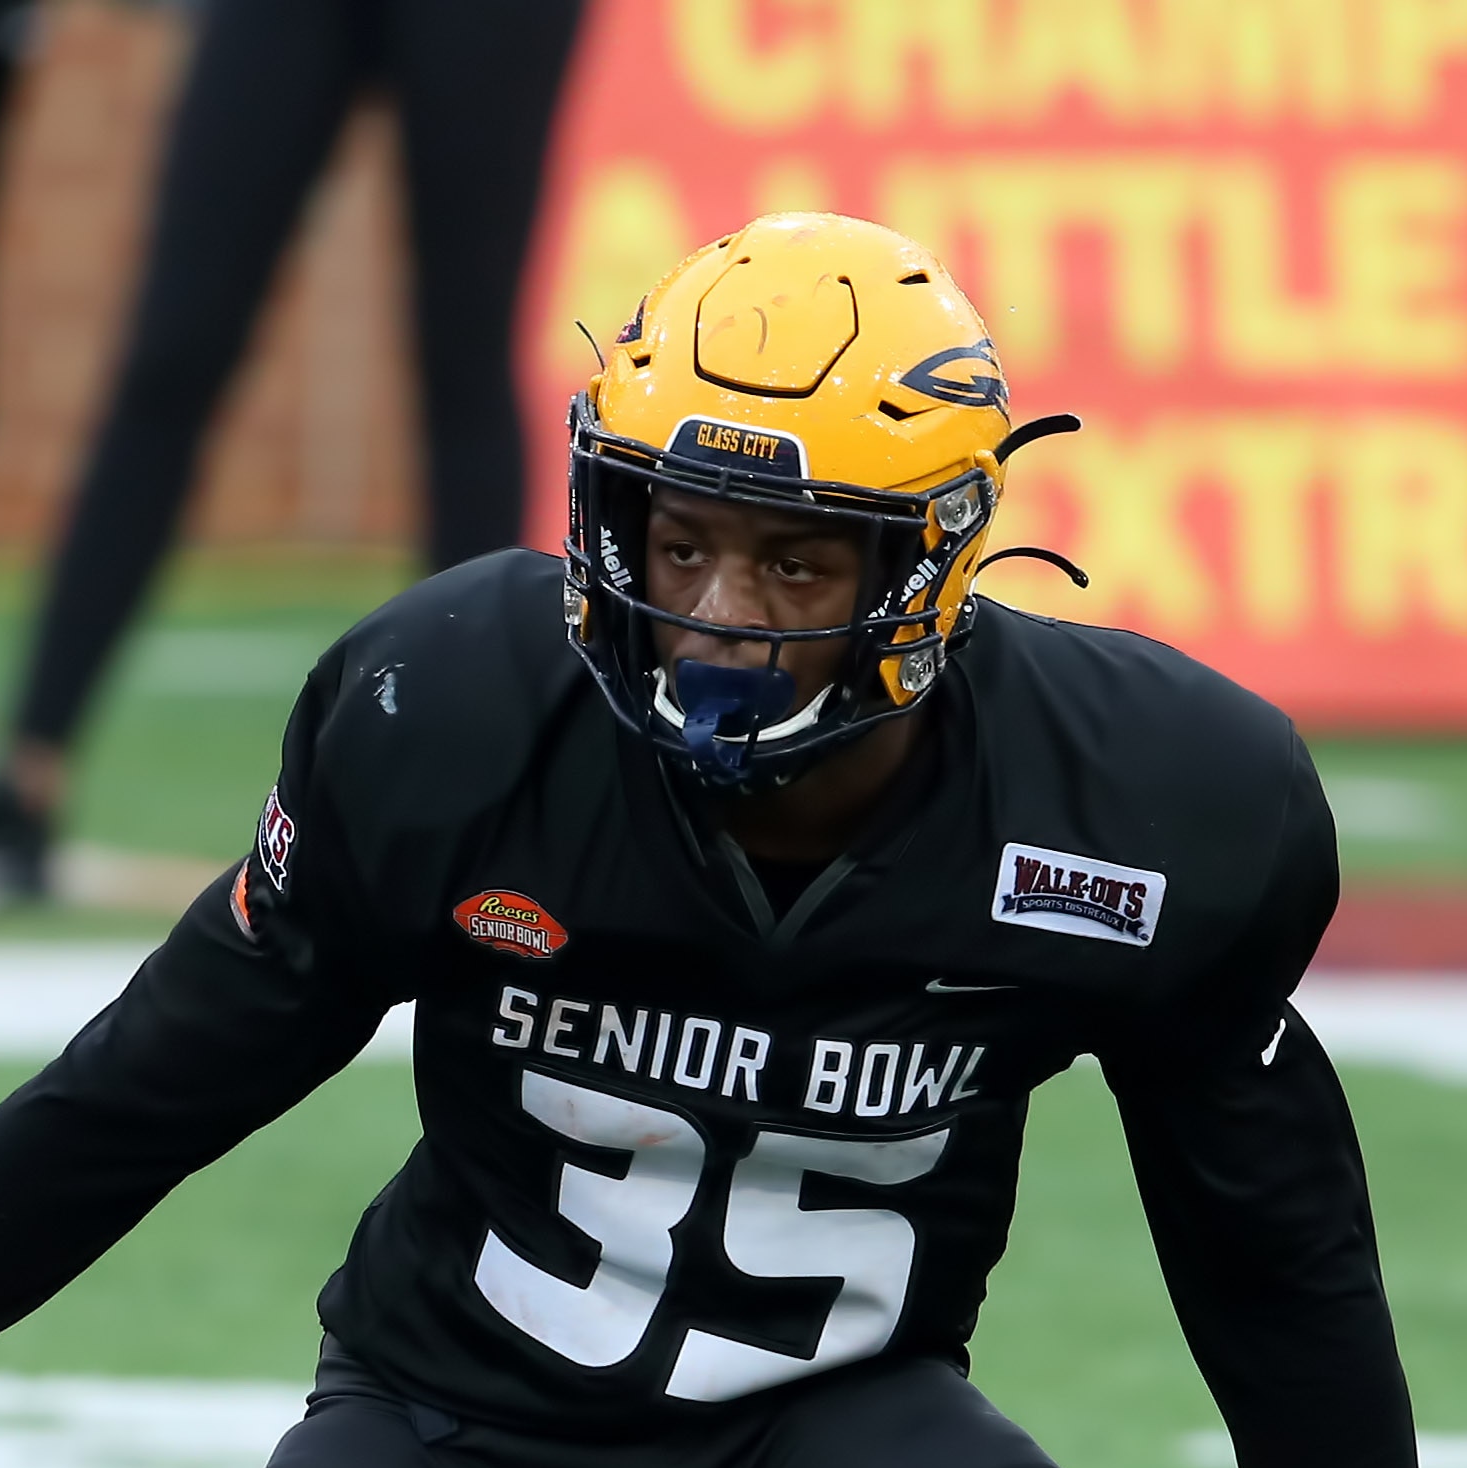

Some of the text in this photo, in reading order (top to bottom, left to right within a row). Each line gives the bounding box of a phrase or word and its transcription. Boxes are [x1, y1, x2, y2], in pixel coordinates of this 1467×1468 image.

[696, 424, 780, 460] GLASS CITY
[1022, 899, 1064, 909] SPORTS
[472, 917, 550, 954] SENIOR BOWL
[491, 985, 986, 1118] SENIOR BOWL
[474, 1068, 950, 1402] 35
